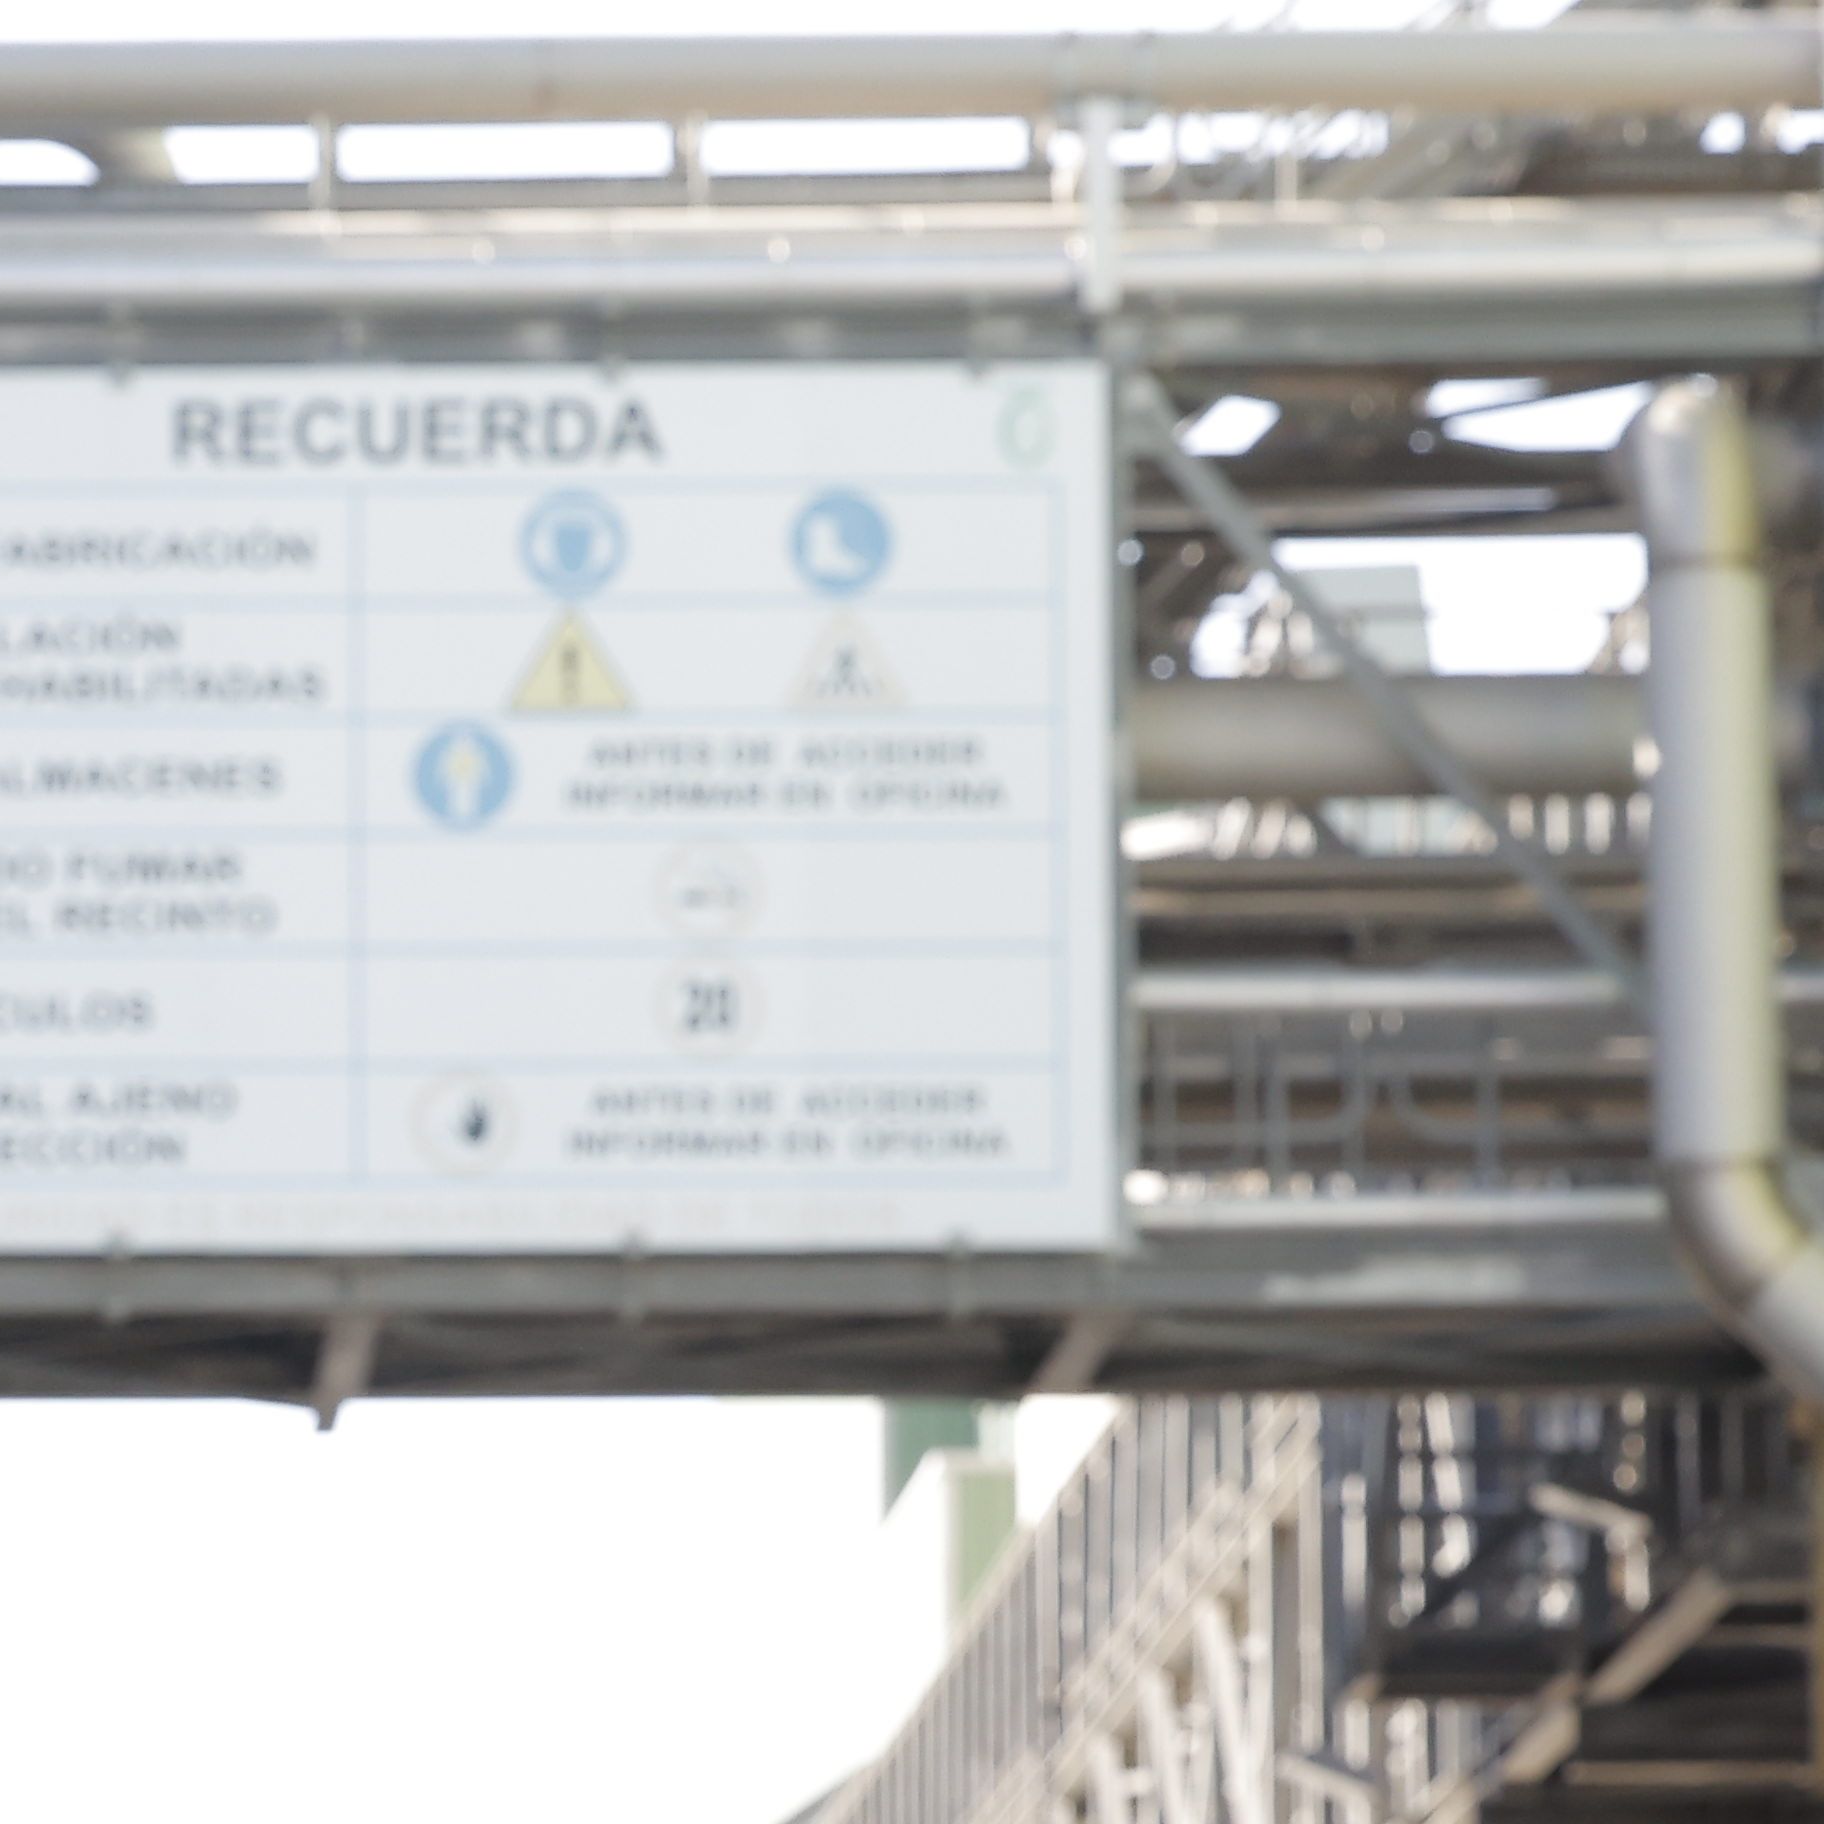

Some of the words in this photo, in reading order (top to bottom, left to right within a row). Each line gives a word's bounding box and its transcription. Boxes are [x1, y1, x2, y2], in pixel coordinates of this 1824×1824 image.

[170, 394, 666, 467] RECUERDA
[63, 848, 244, 890] FUMAR
[53, 898, 280, 939] RECINTO
[68, 1080, 242, 1122] AJENO
